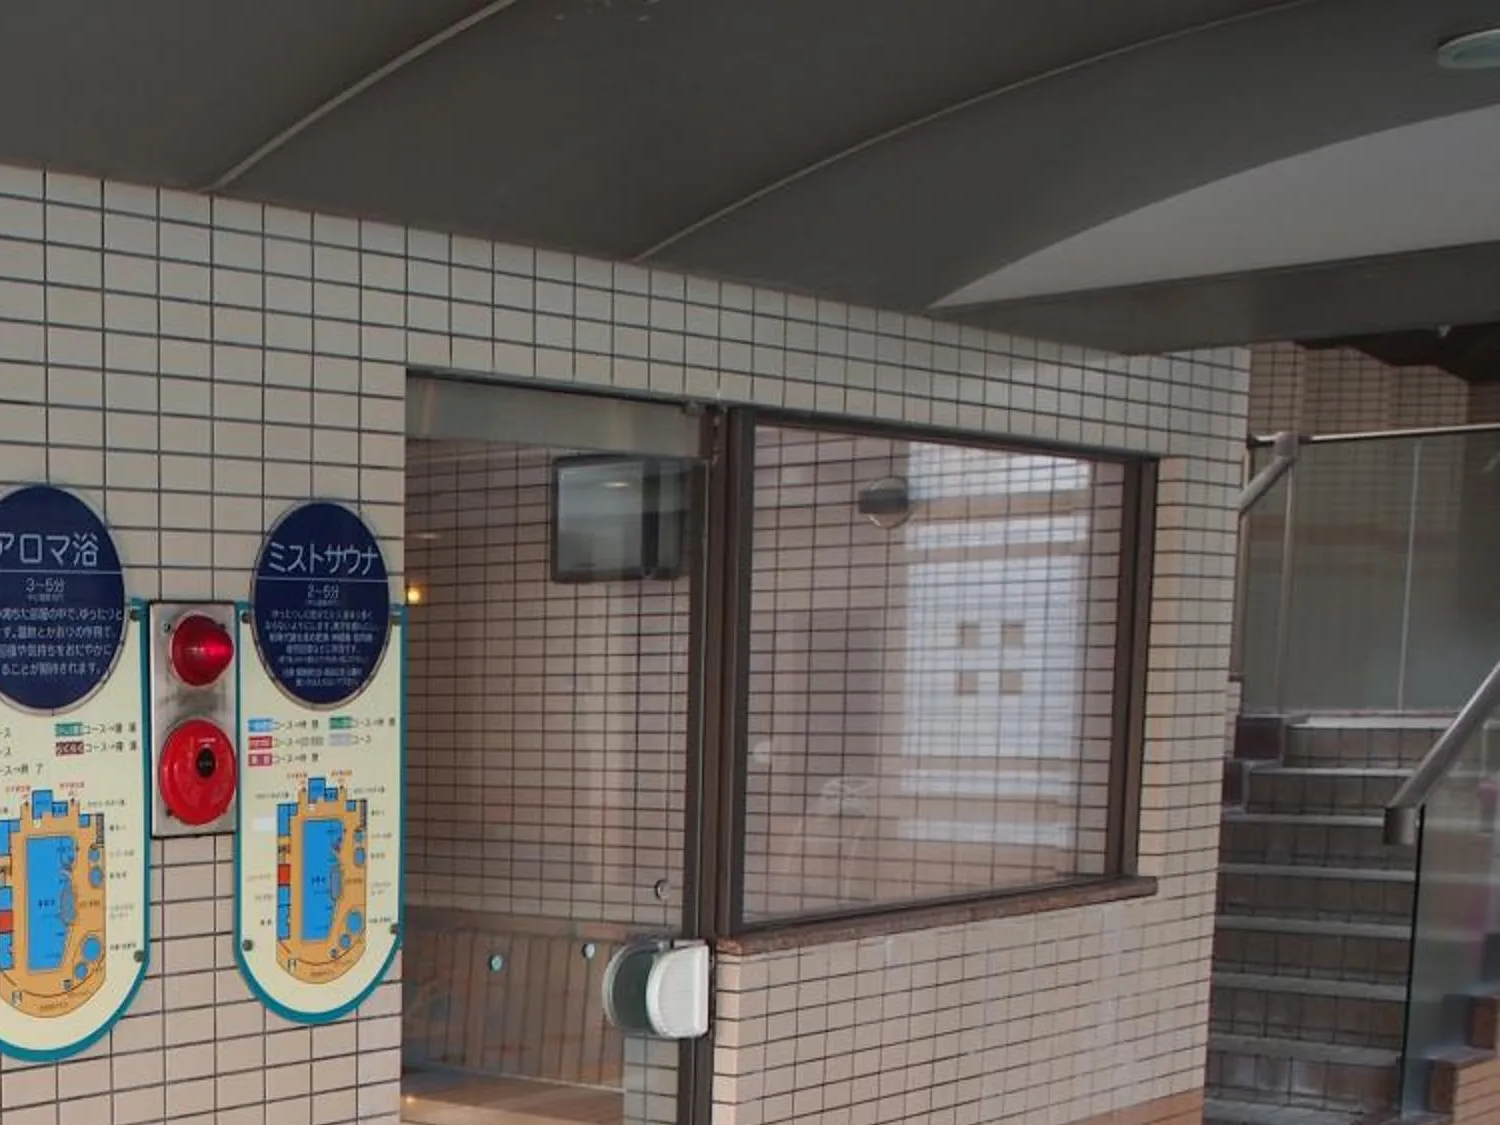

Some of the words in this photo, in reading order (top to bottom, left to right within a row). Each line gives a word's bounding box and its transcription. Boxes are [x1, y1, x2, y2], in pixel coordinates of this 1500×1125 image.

[268, 541, 379, 576] ミストサウナ
